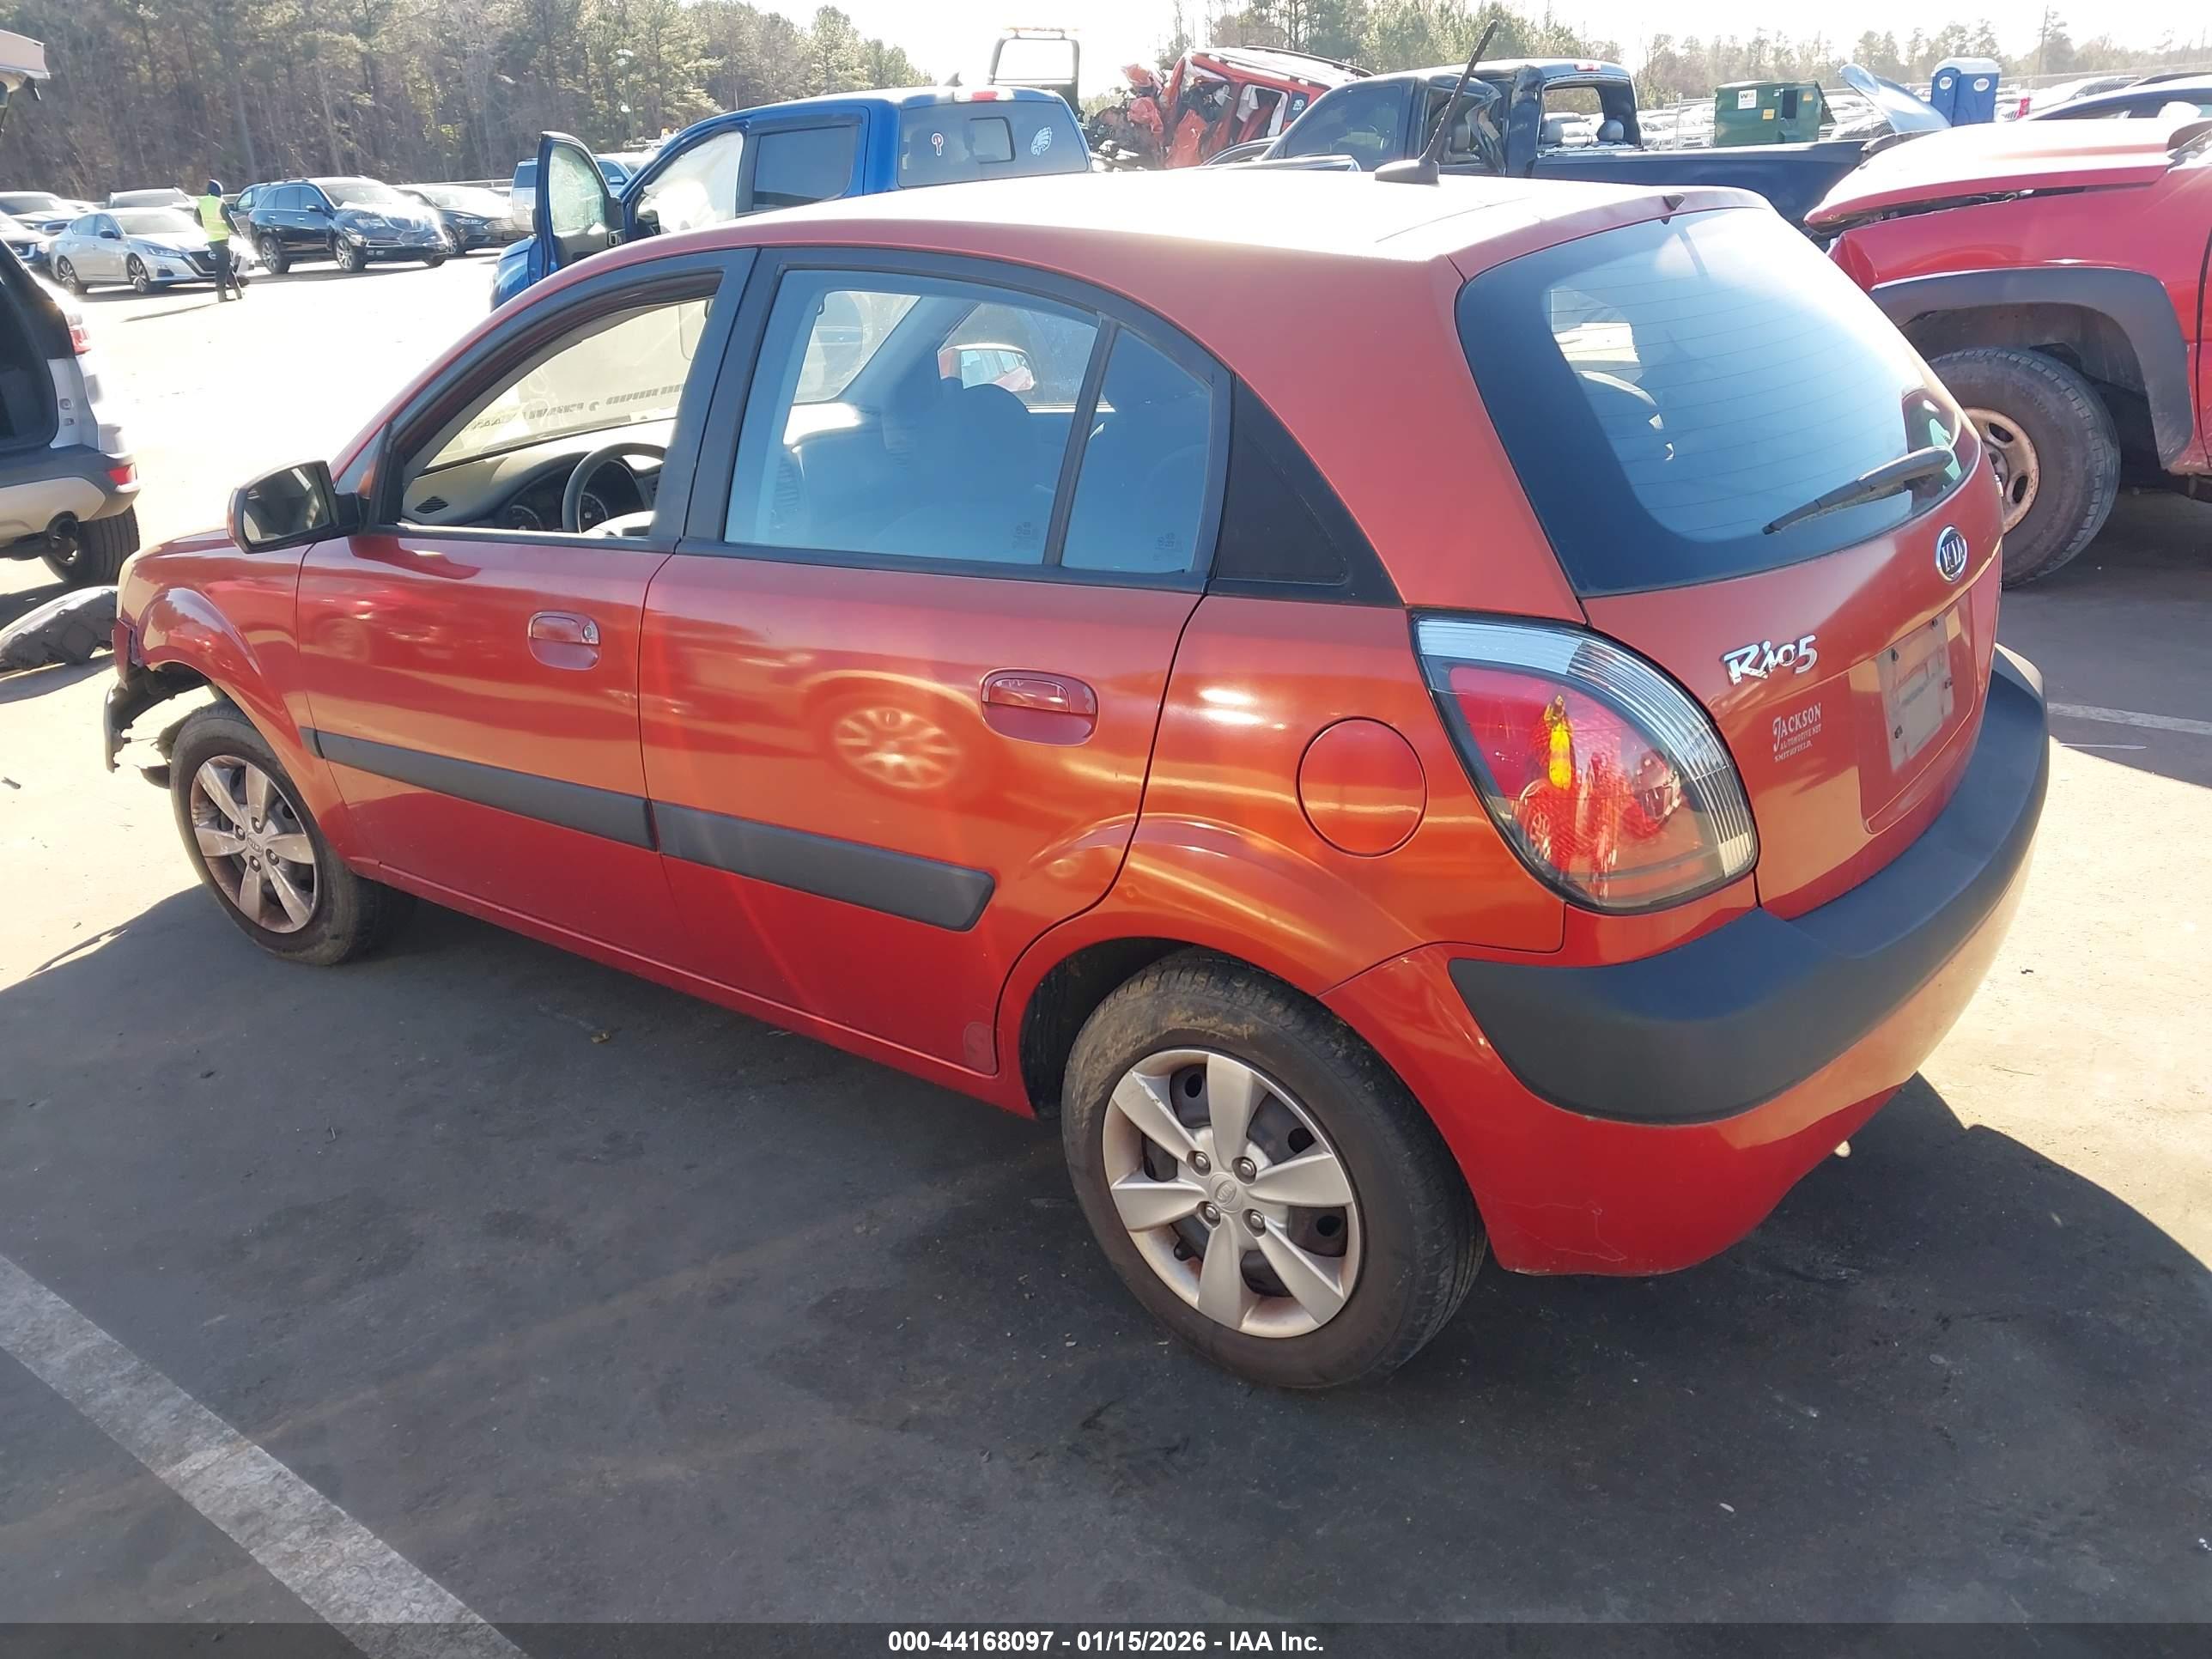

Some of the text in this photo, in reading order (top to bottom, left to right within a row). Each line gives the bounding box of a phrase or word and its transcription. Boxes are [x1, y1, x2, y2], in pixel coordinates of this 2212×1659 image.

[1940, 534, 1966, 574] KIA
[1723, 635, 1818, 685] Rio5
[1772, 702, 1821, 752] JACKSON
